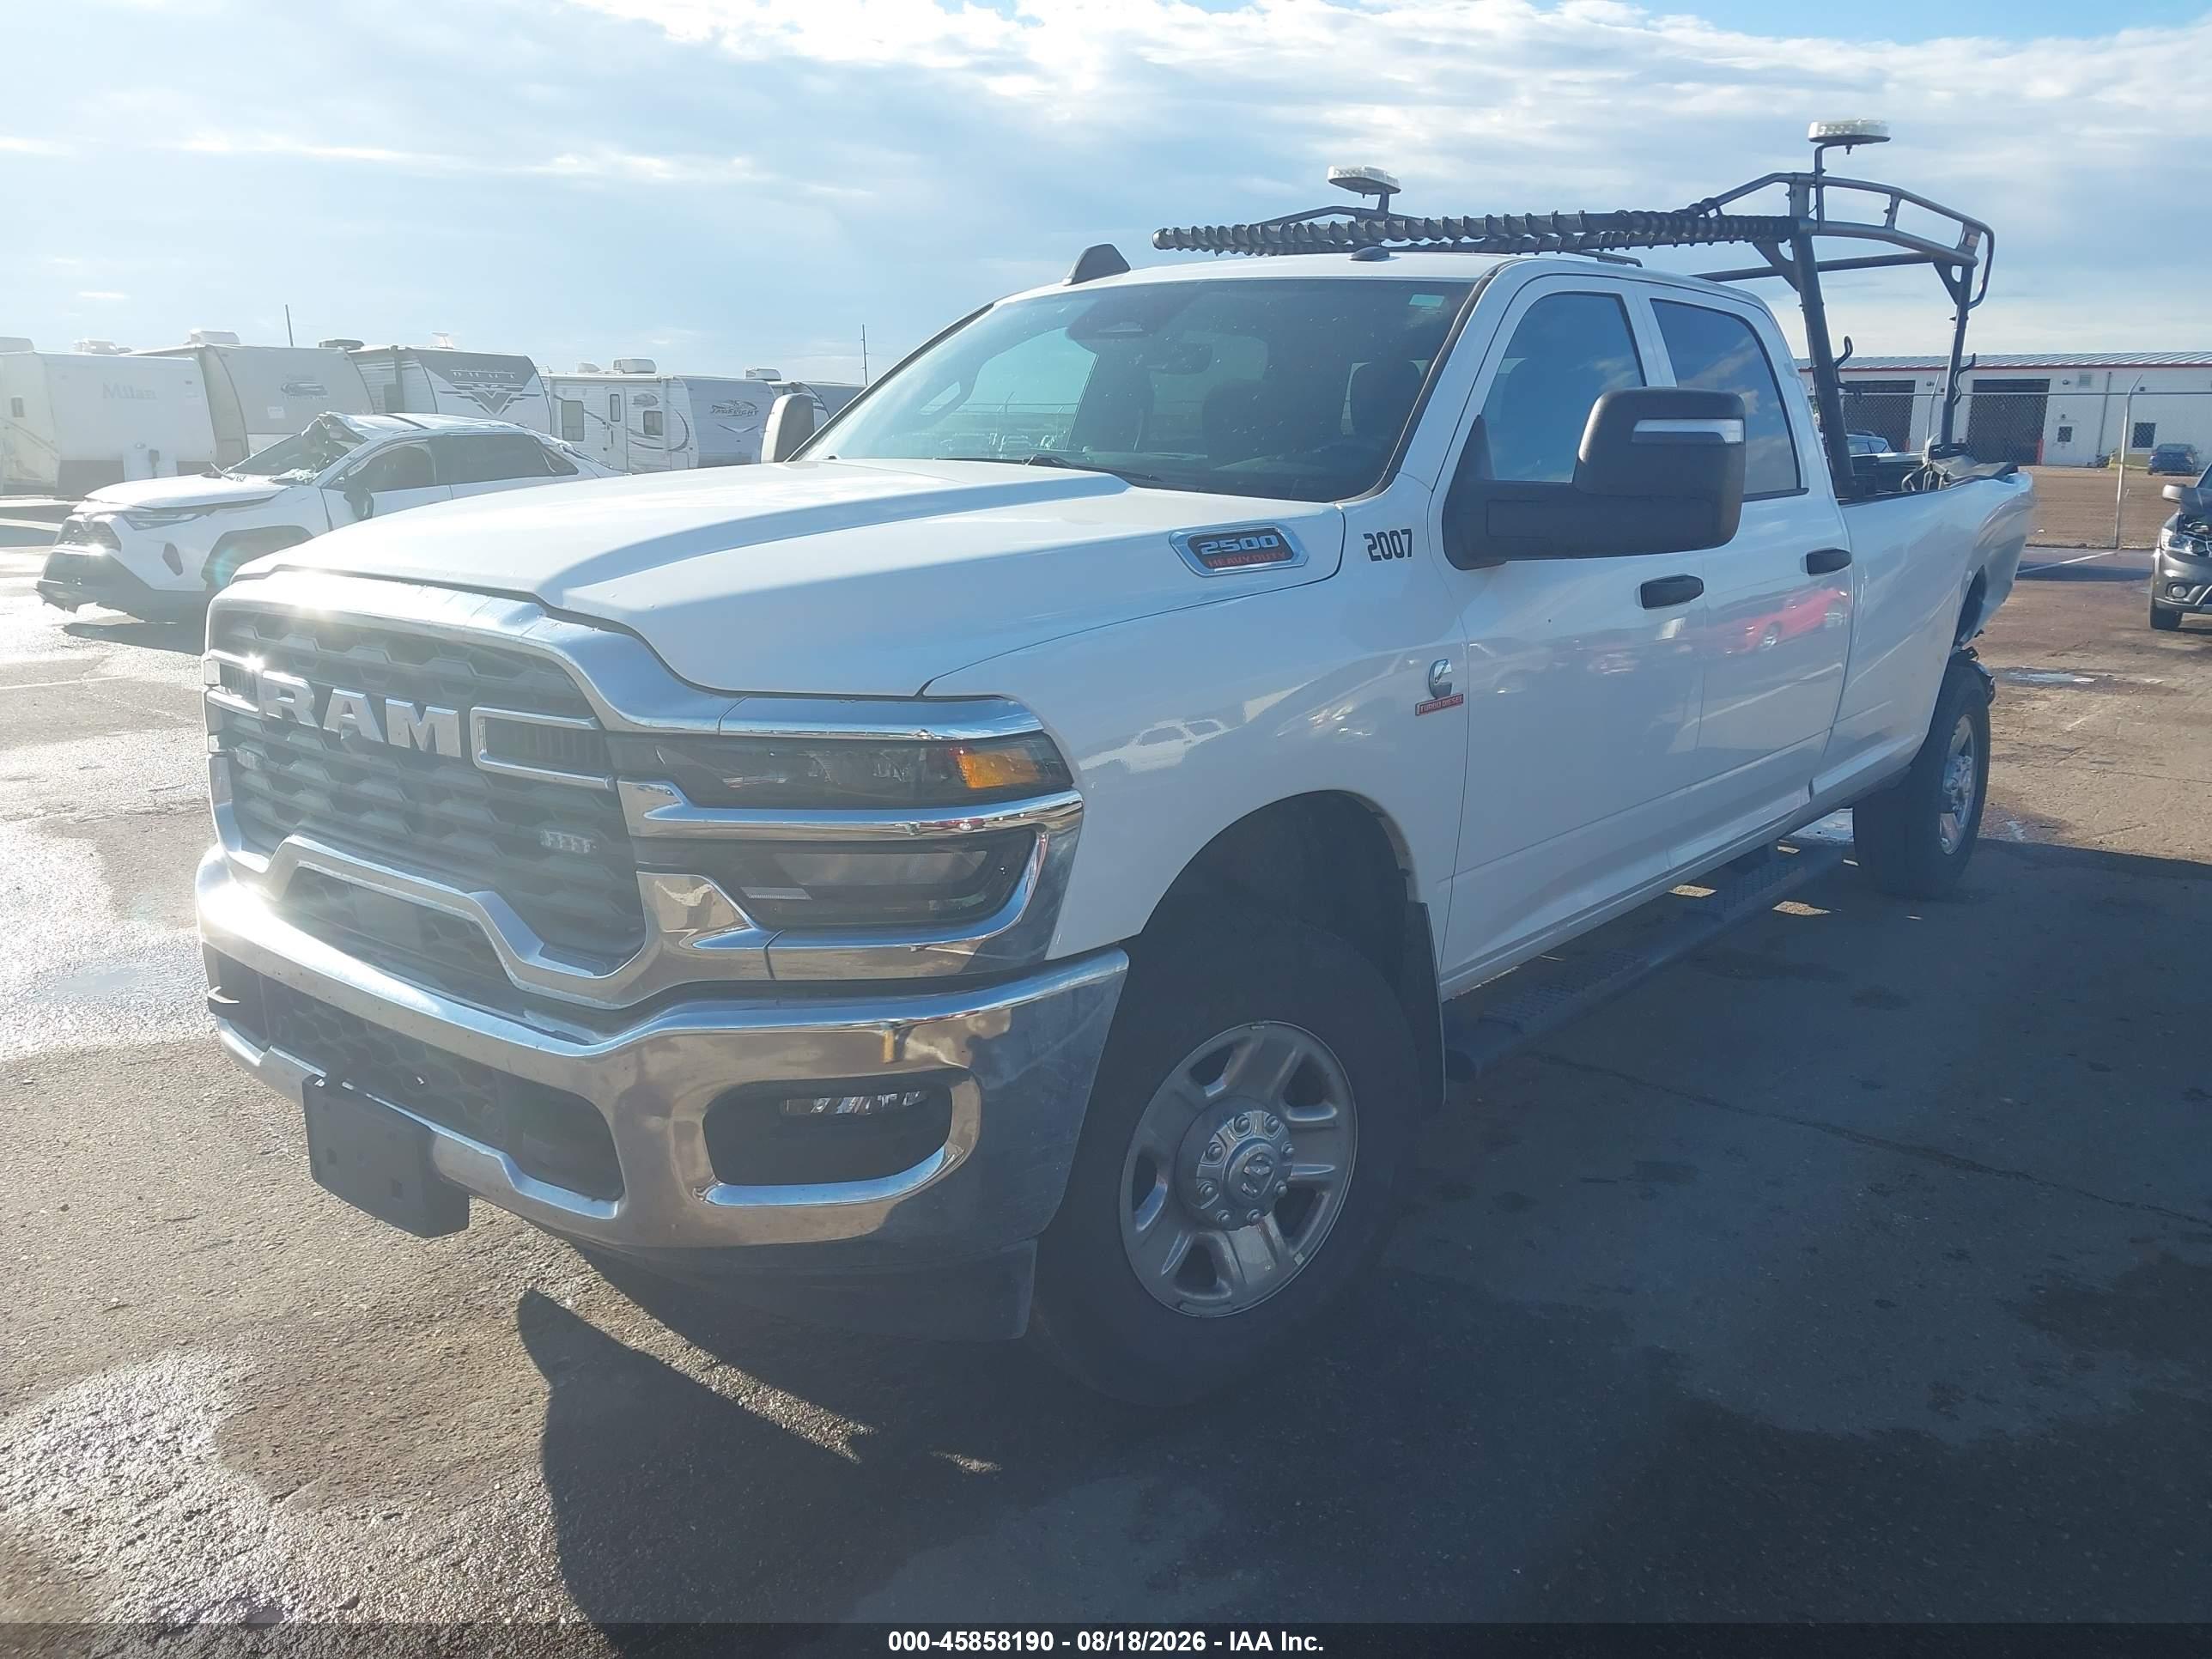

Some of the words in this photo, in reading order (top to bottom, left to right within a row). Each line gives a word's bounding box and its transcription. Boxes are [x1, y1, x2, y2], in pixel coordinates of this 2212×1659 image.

[1197, 534, 1279, 555] 2500
[1363, 528, 1413, 562] 2007
[1208, 556, 1252, 567] HEAVY
[1252, 551, 1285, 562] DUTY
[258, 670, 462, 758] RAM
